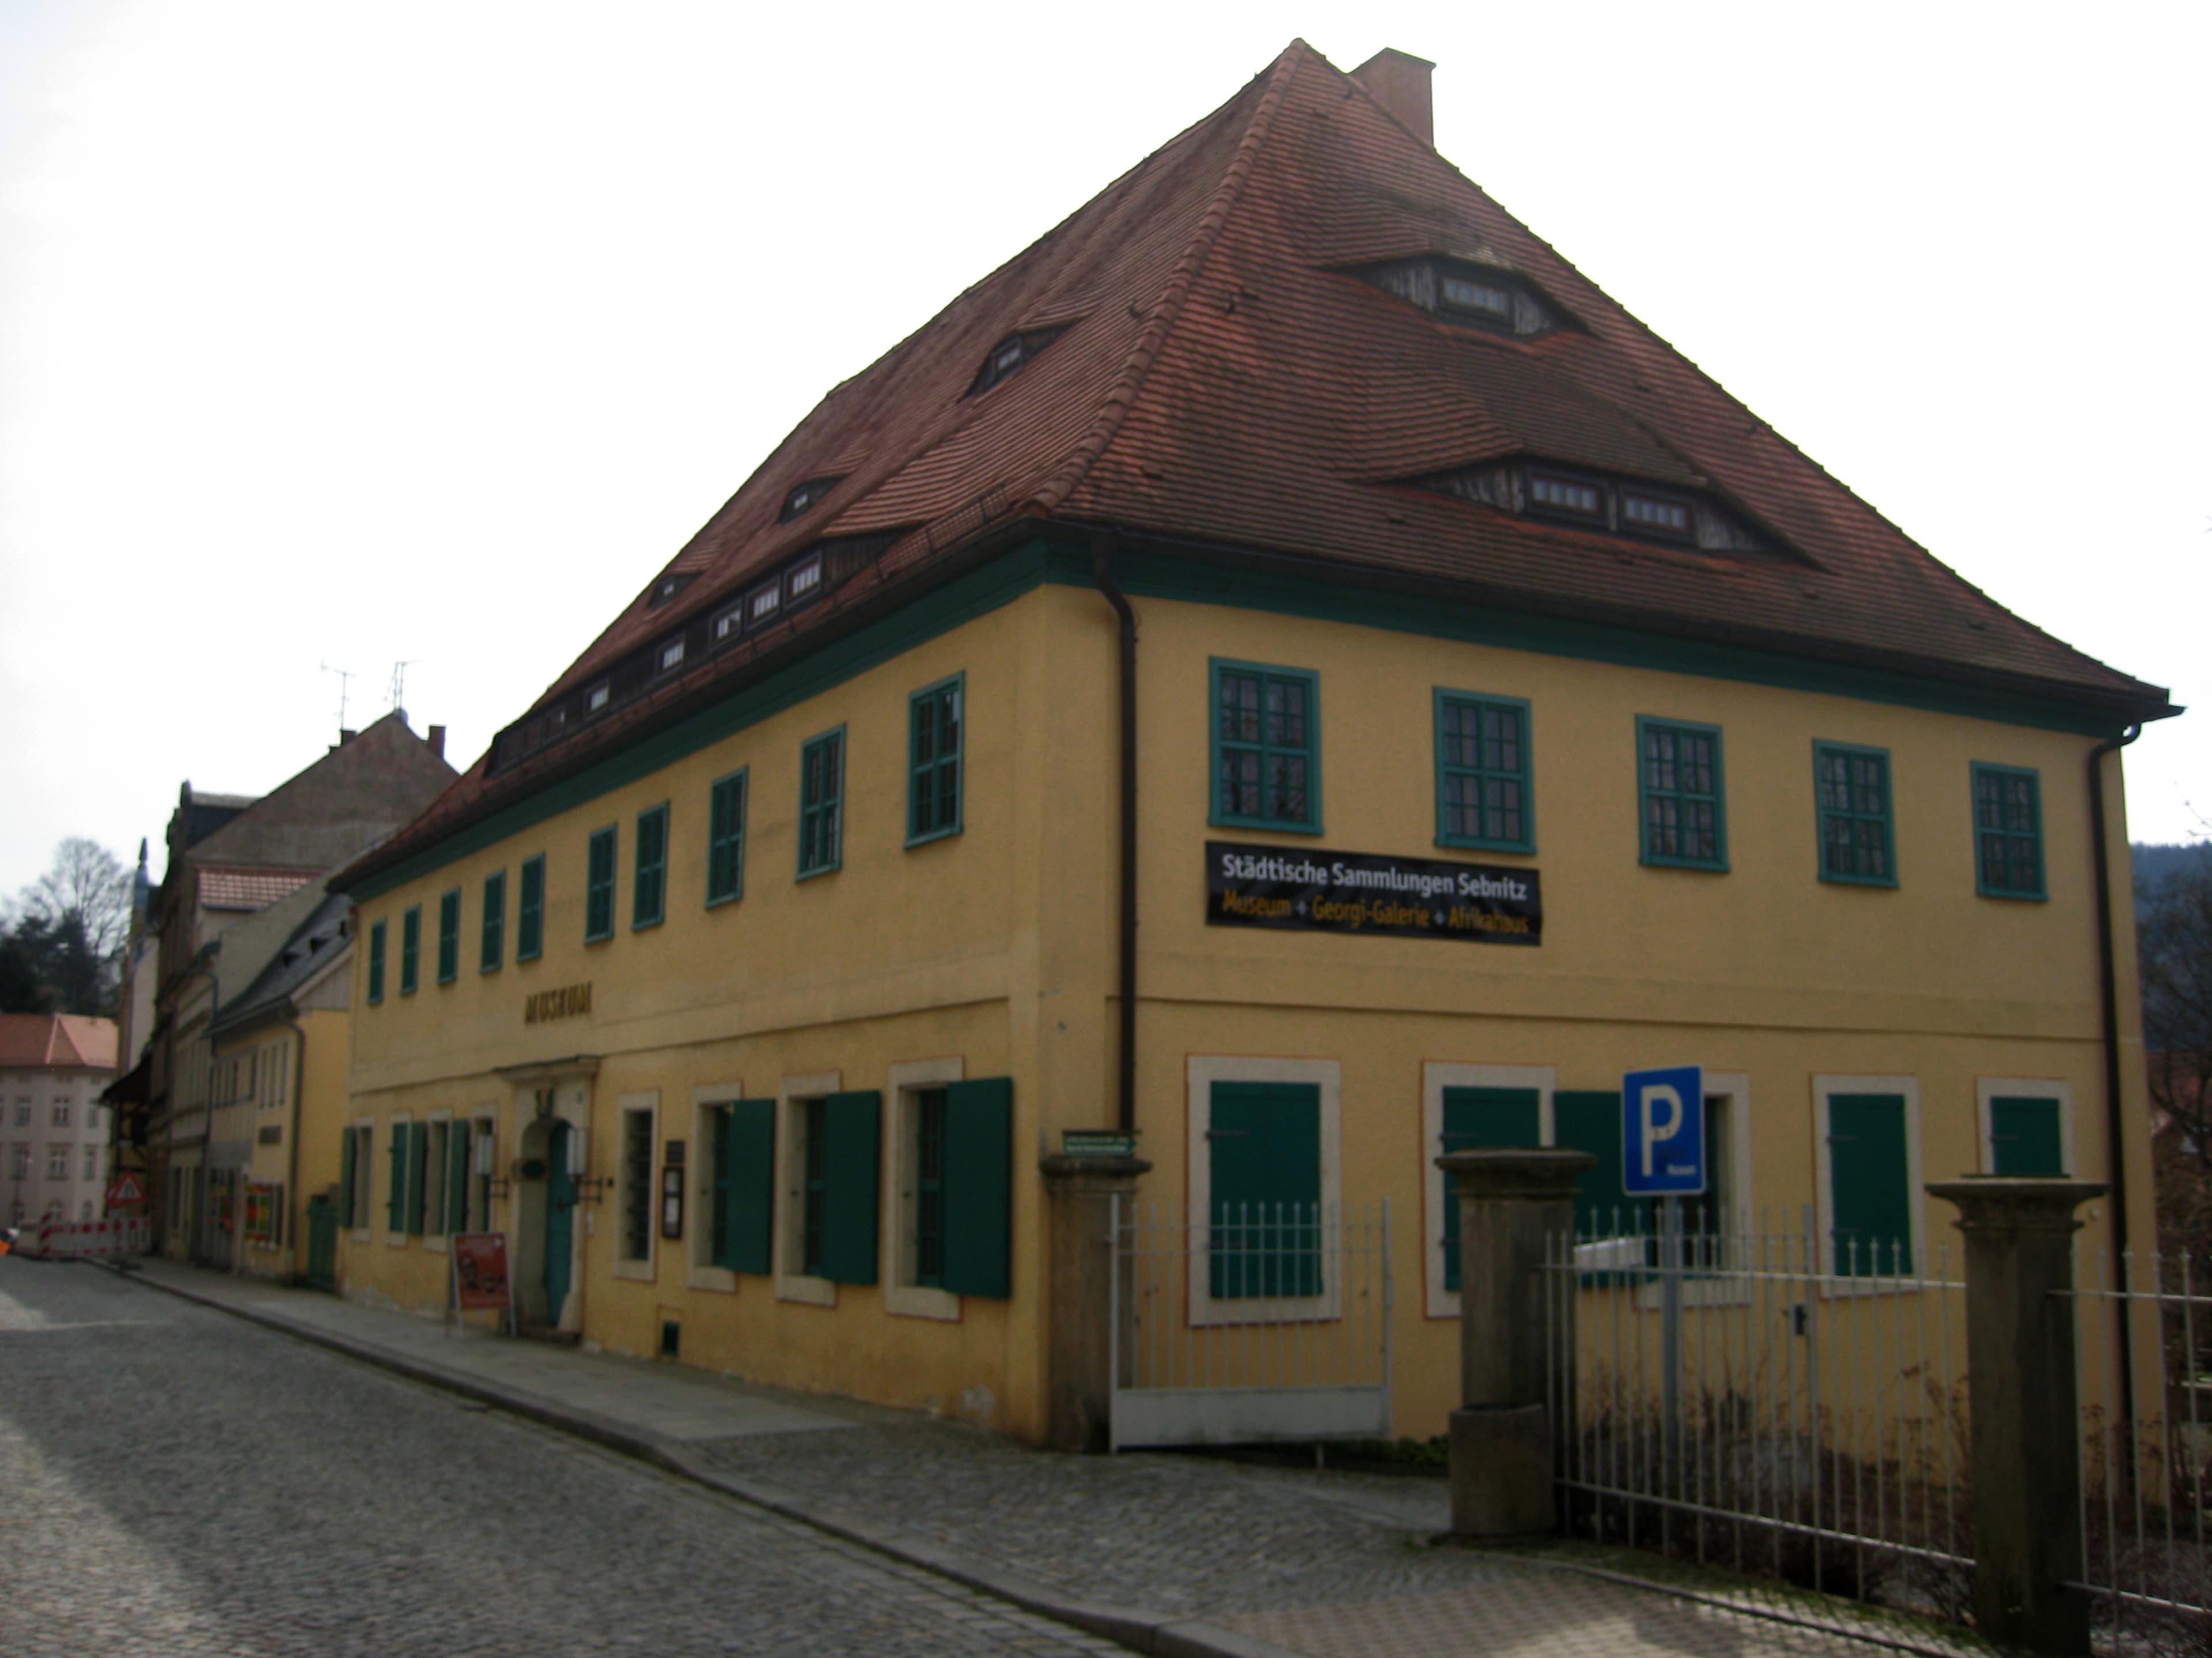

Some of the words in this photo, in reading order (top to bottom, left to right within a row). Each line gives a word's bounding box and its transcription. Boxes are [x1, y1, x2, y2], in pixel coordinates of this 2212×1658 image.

[1222, 853, 1328, 885] Städtische
[1332, 862, 1455, 898] Sammlungen
[1459, 873, 1528, 900] Sebnitz
[1222, 889, 1291, 917] Museum
[1312, 895, 1430, 928] Georgi-Galerie
[1641, 1083, 1683, 1176] P
